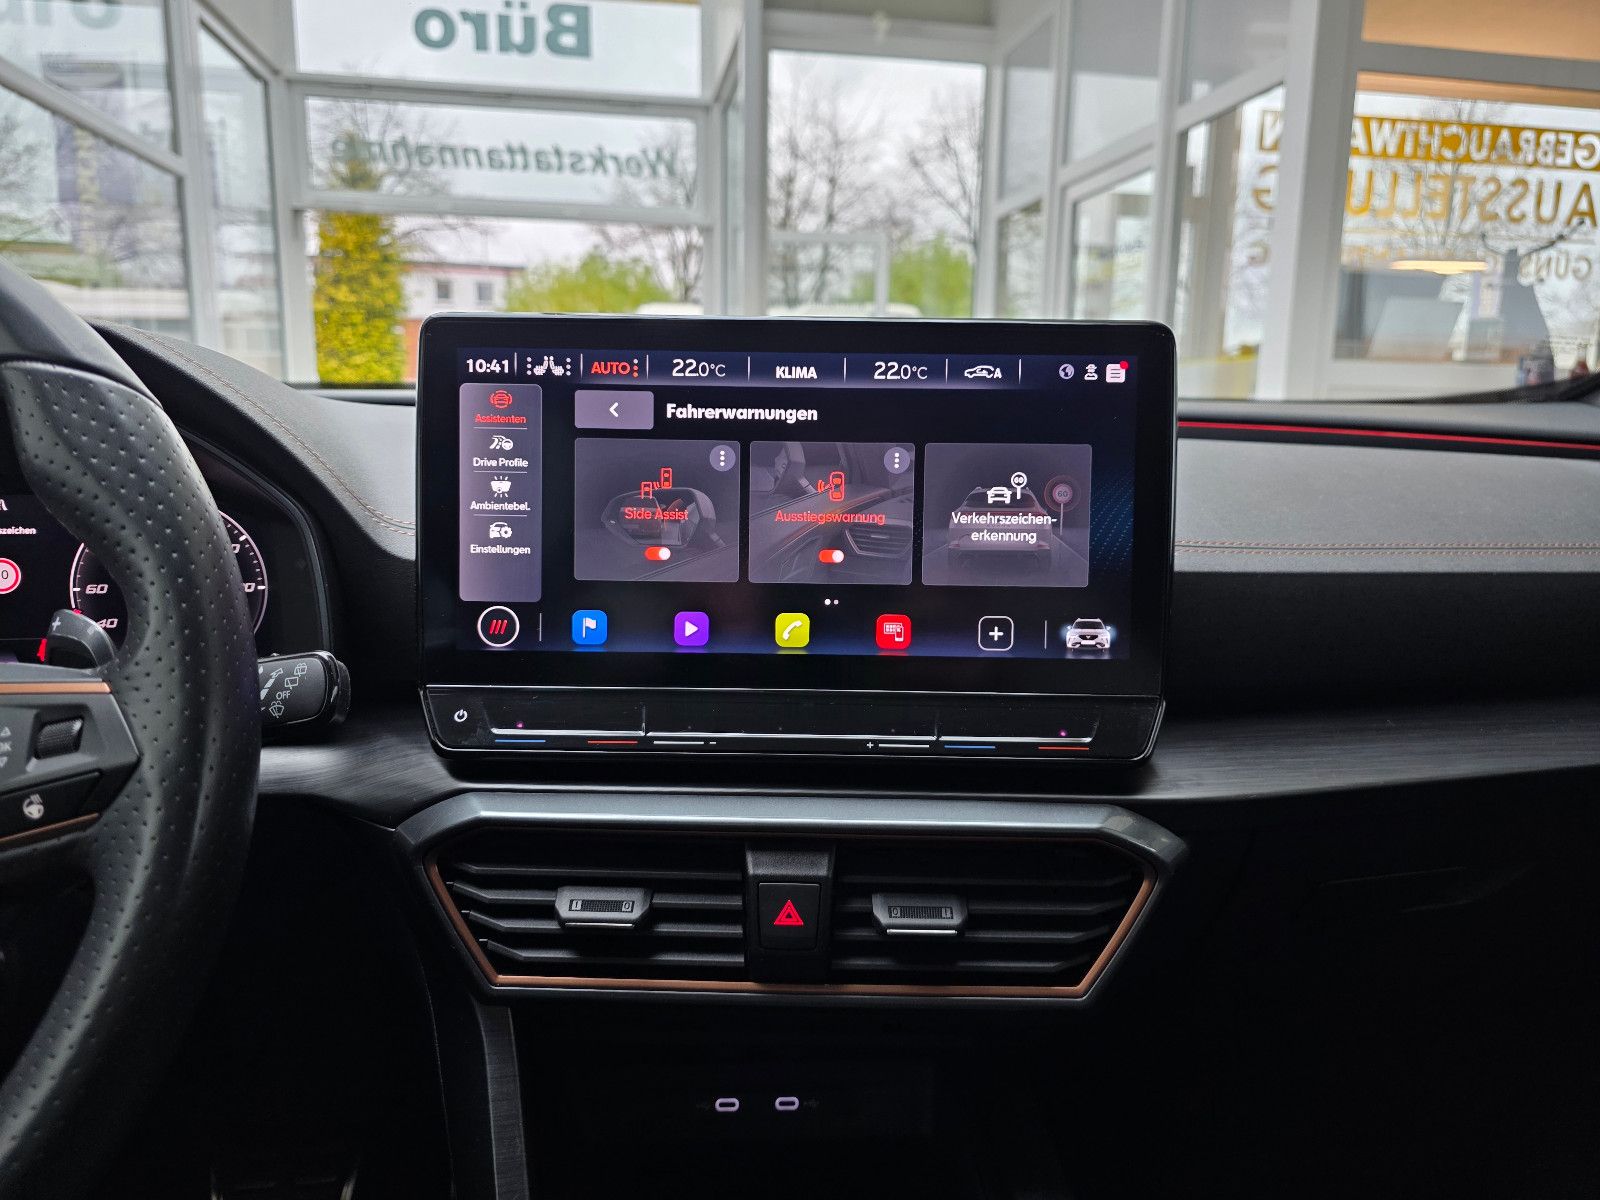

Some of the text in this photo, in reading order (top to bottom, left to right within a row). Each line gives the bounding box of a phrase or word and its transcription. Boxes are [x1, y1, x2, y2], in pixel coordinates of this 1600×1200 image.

[466, 358, 509, 374] 10:41
[591, 361, 631, 375] AUTO
[775, 365, 818, 379] KLIMA
[475, 413, 527, 424] Assistenten
[666, 403, 818, 424] Fahrerwarnungen
[472, 457, 529, 468] Drive Profile
[470, 500, 531, 511] Ambientebel.
[624, 507, 689, 521] Side Assist
[774, 509, 886, 527] Ausstiegswarnung
[951, 511, 1058, 525] Verkehrszeichen-
[970, 529, 1037, 545] erkennung
[470, 544, 531, 556] Einstellungen
[85, 584, 109, 594] 60
[275, 690, 292, 701] OFF
